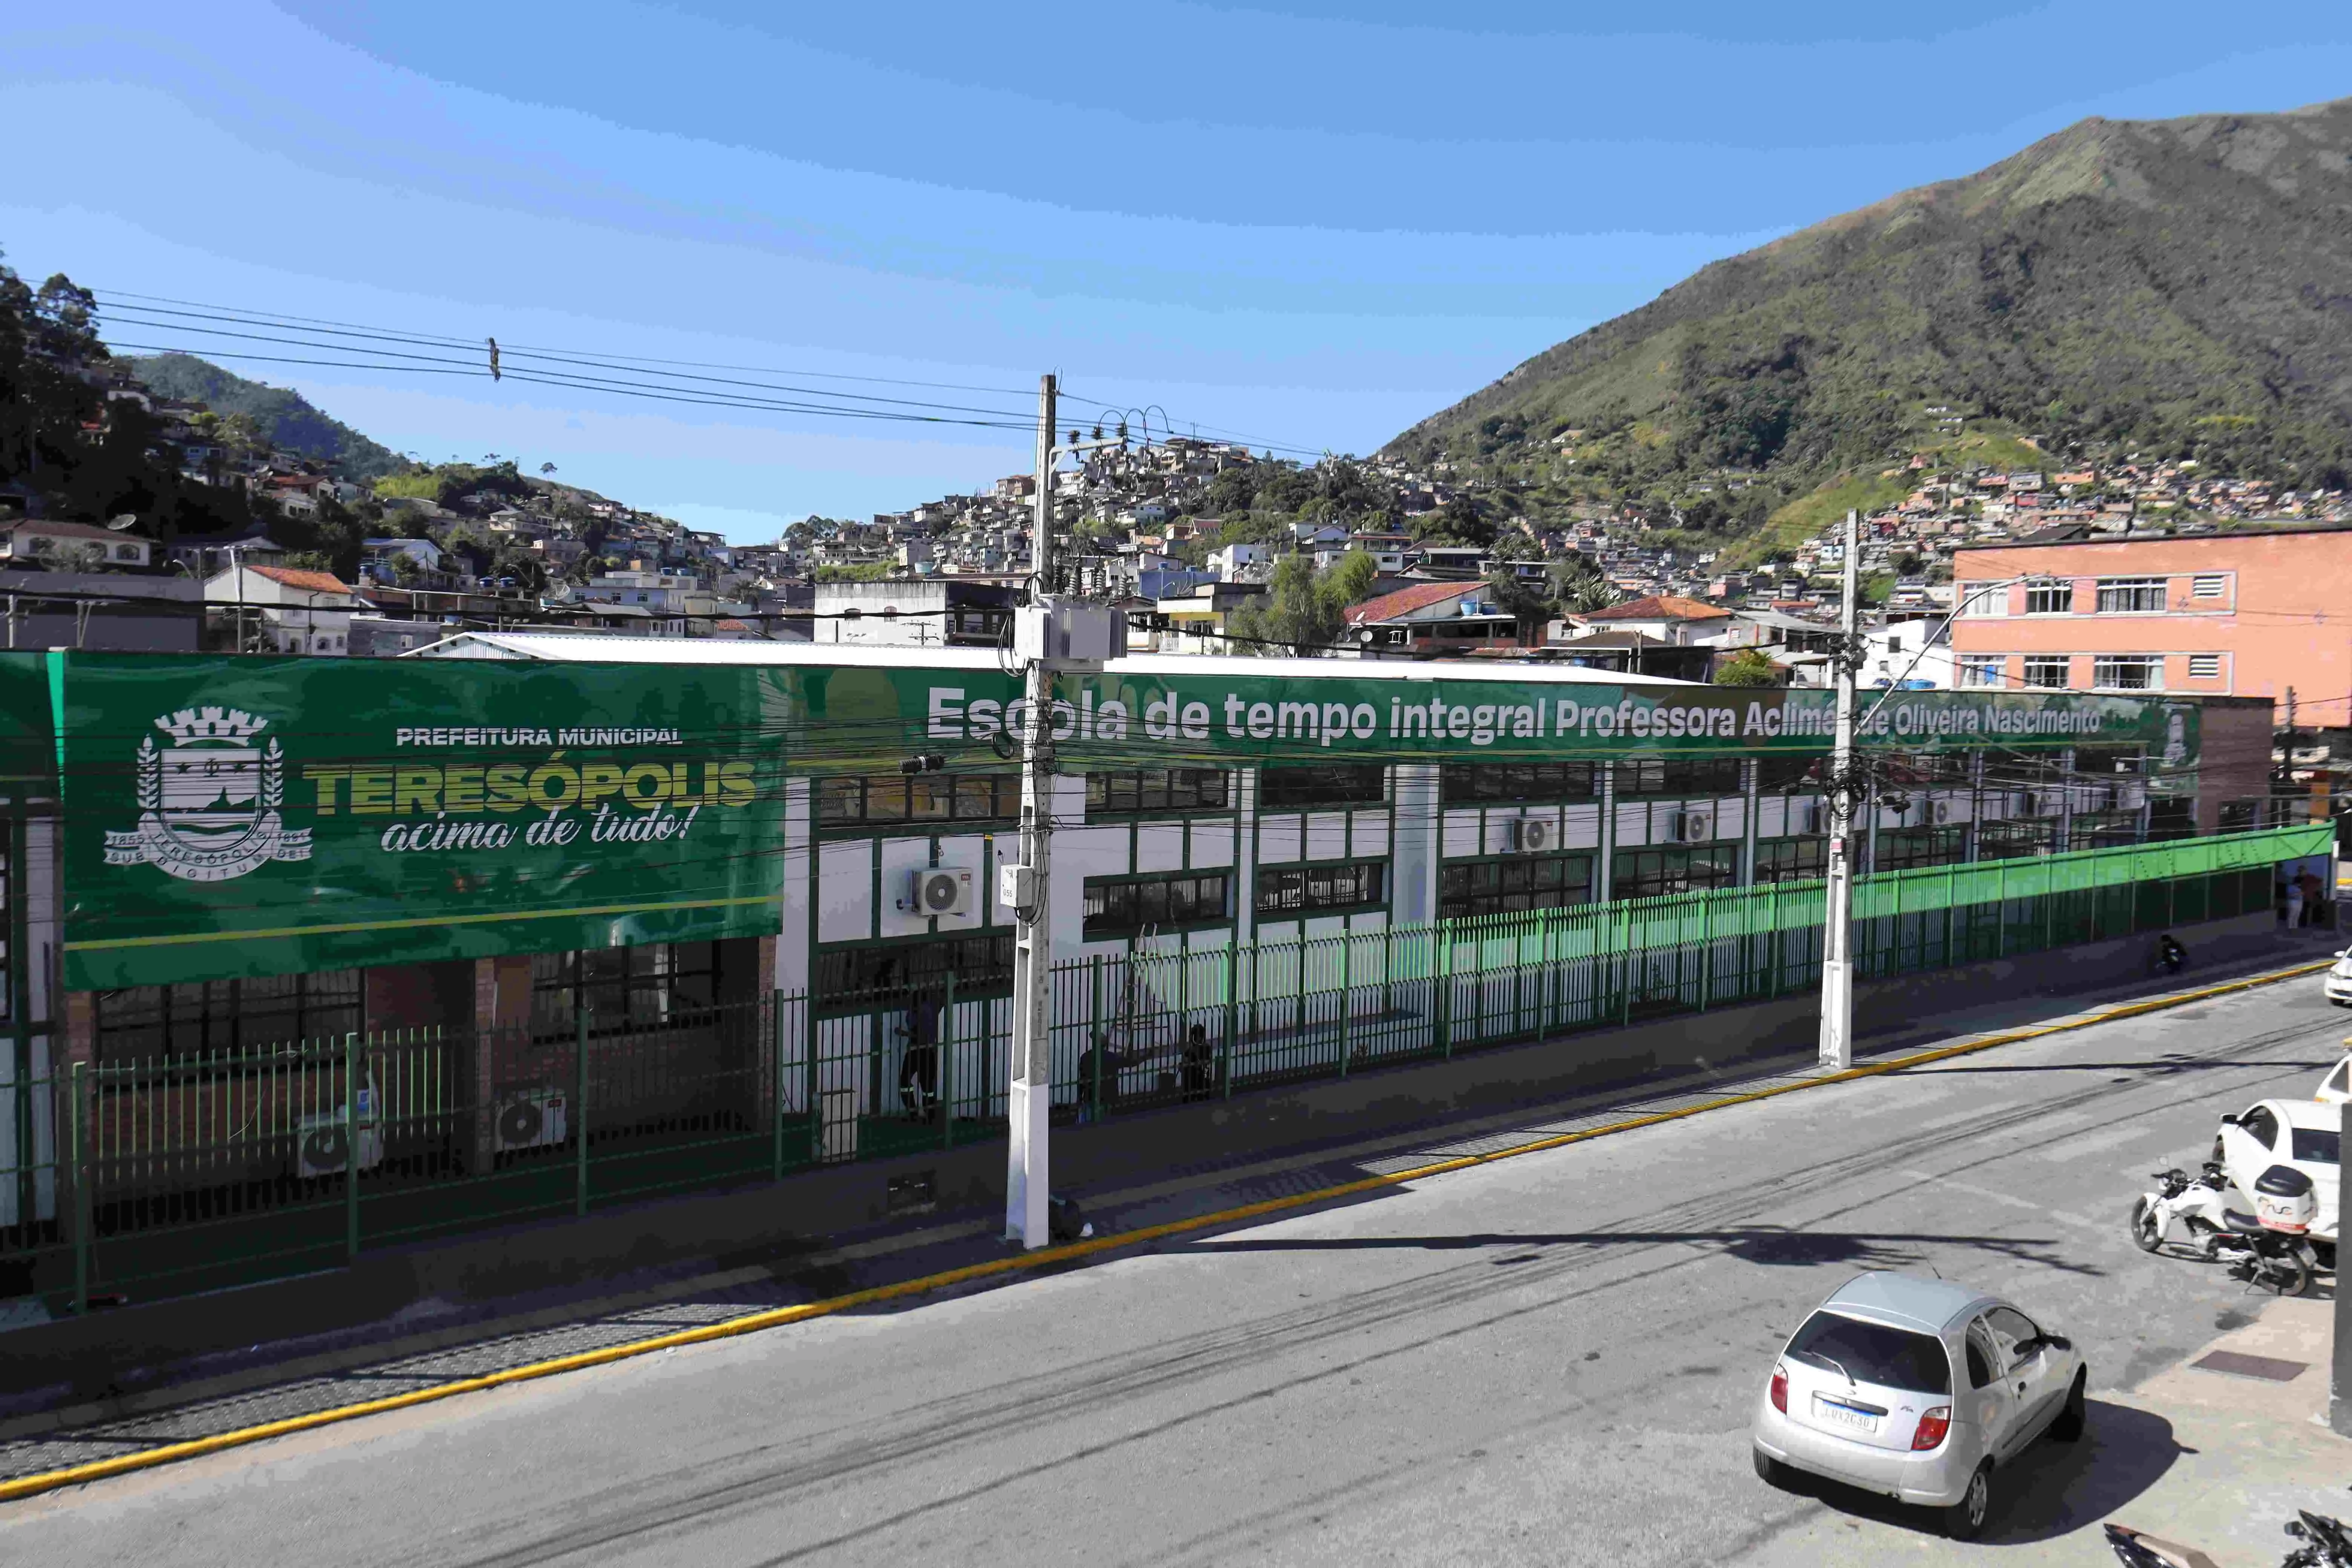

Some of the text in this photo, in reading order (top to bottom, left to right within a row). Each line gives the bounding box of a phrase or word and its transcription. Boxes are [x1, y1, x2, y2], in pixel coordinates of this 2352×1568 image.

[397, 728, 683, 746] PREFEITURA MUNICIPAL
[927, 687, 2101, 746] Escola de tempo integral Professora Aclimé de Oliveira Nascimento
[302, 751, 756, 815] TERESÓPOLIS
[381, 801, 701, 852] acima de tudo!
